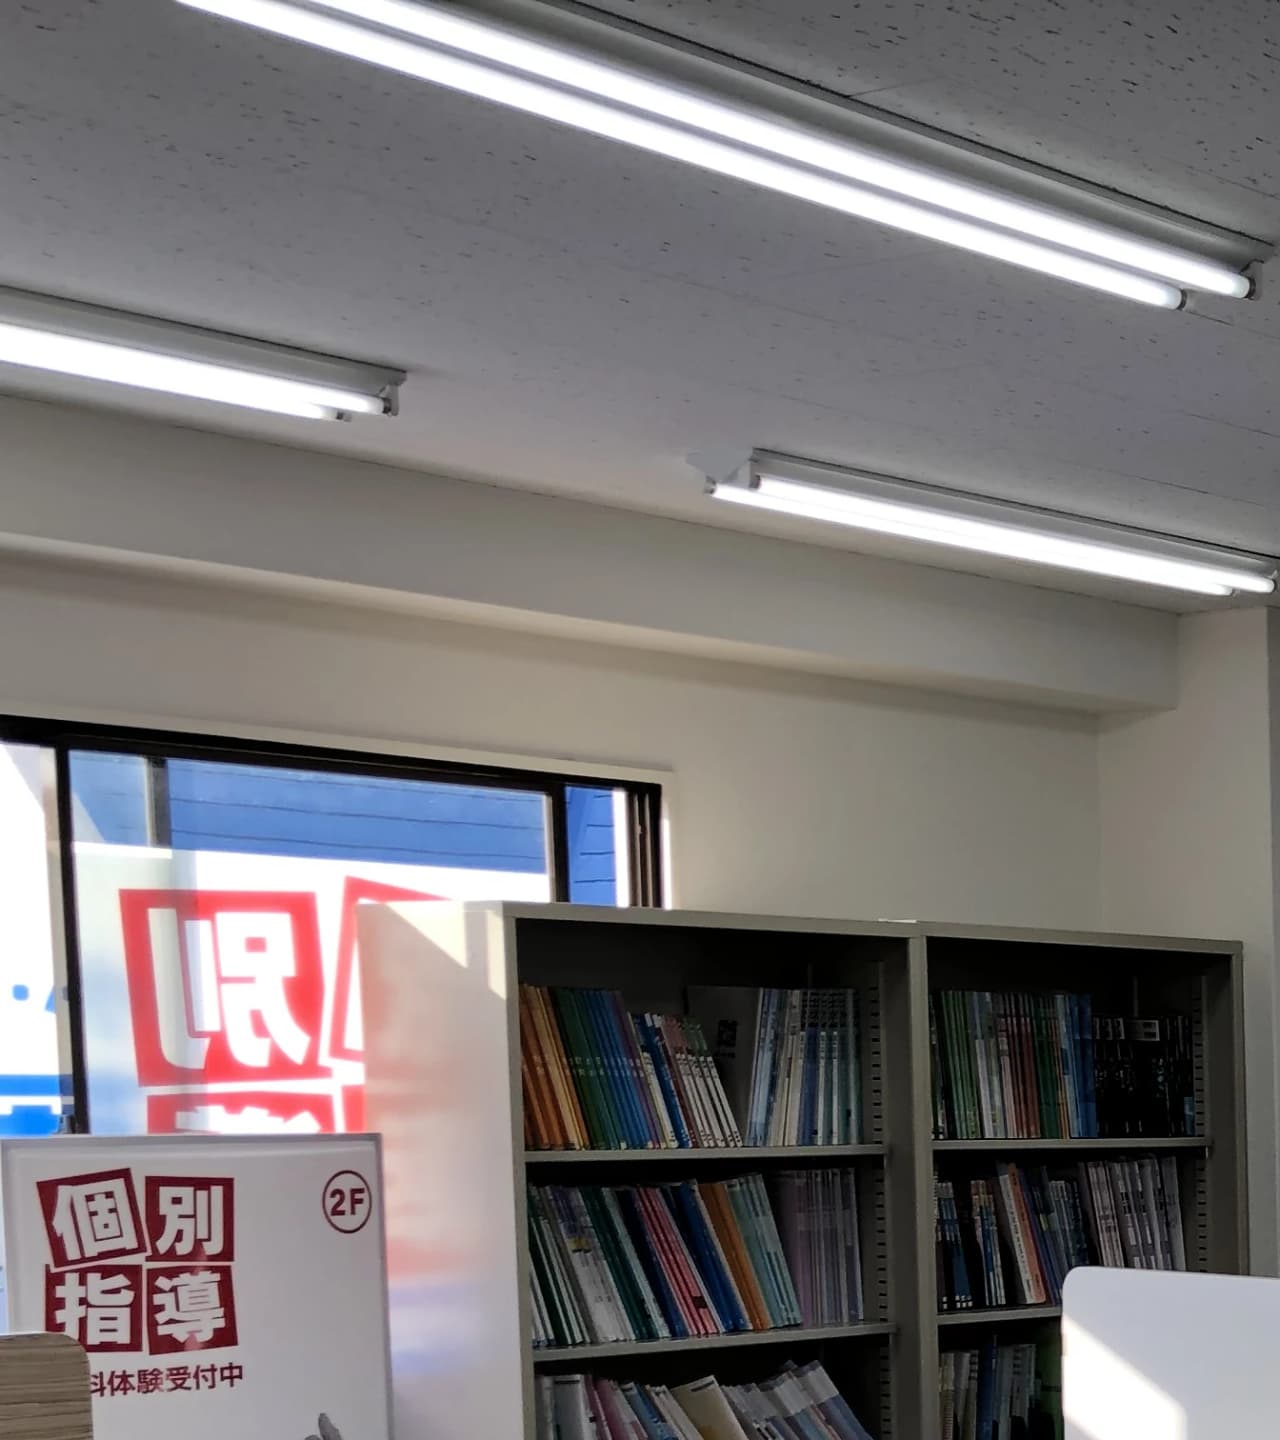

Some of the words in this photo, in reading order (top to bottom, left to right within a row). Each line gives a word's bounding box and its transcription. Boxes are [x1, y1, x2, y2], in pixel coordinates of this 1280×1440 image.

[52, 1178, 225, 1260] 個別
[330, 1187, 365, 1216] 2F
[56, 1271, 227, 1345] 指導
